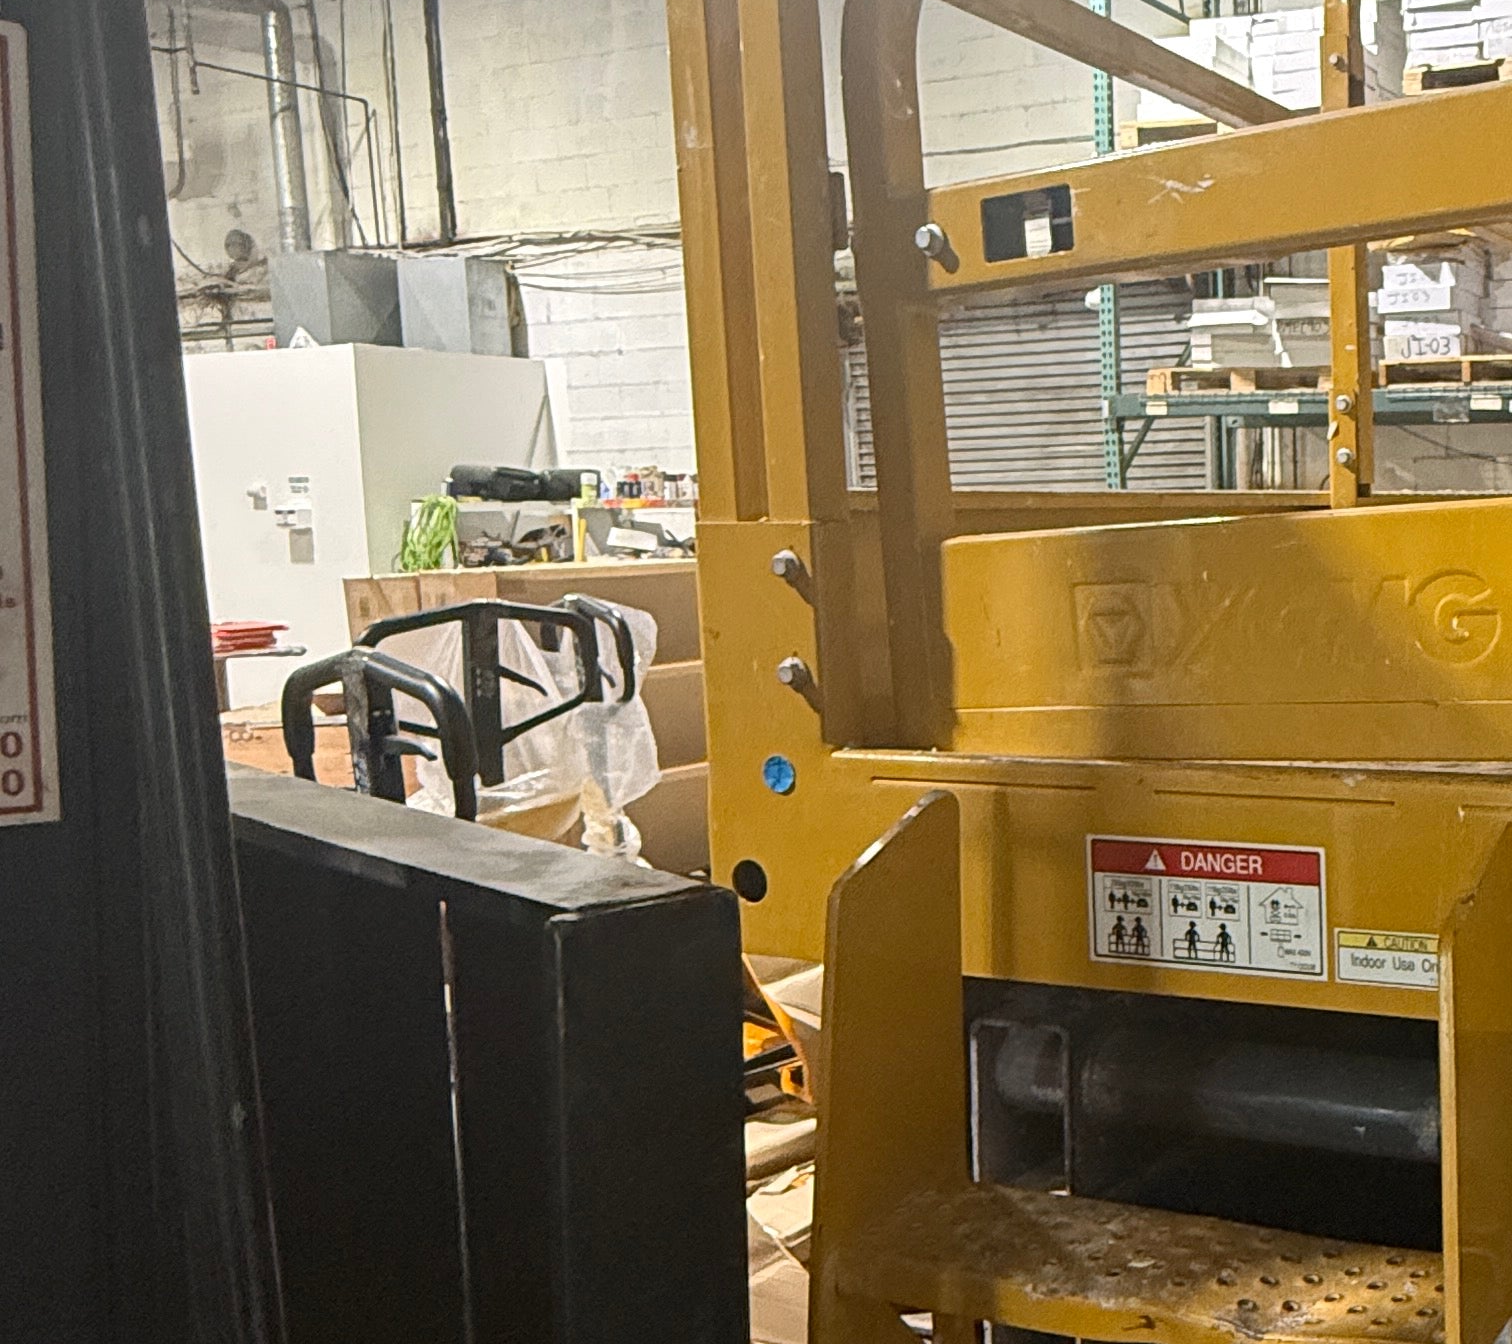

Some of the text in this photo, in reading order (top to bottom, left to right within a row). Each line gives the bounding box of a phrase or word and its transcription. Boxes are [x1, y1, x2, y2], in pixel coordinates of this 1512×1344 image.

[1180, 851, 1263, 875] DANGER
[1384, 935, 1429, 951] CAUTION
[1350, 953, 1387, 970] Indoor
[1392, 956, 1416, 972] Use
